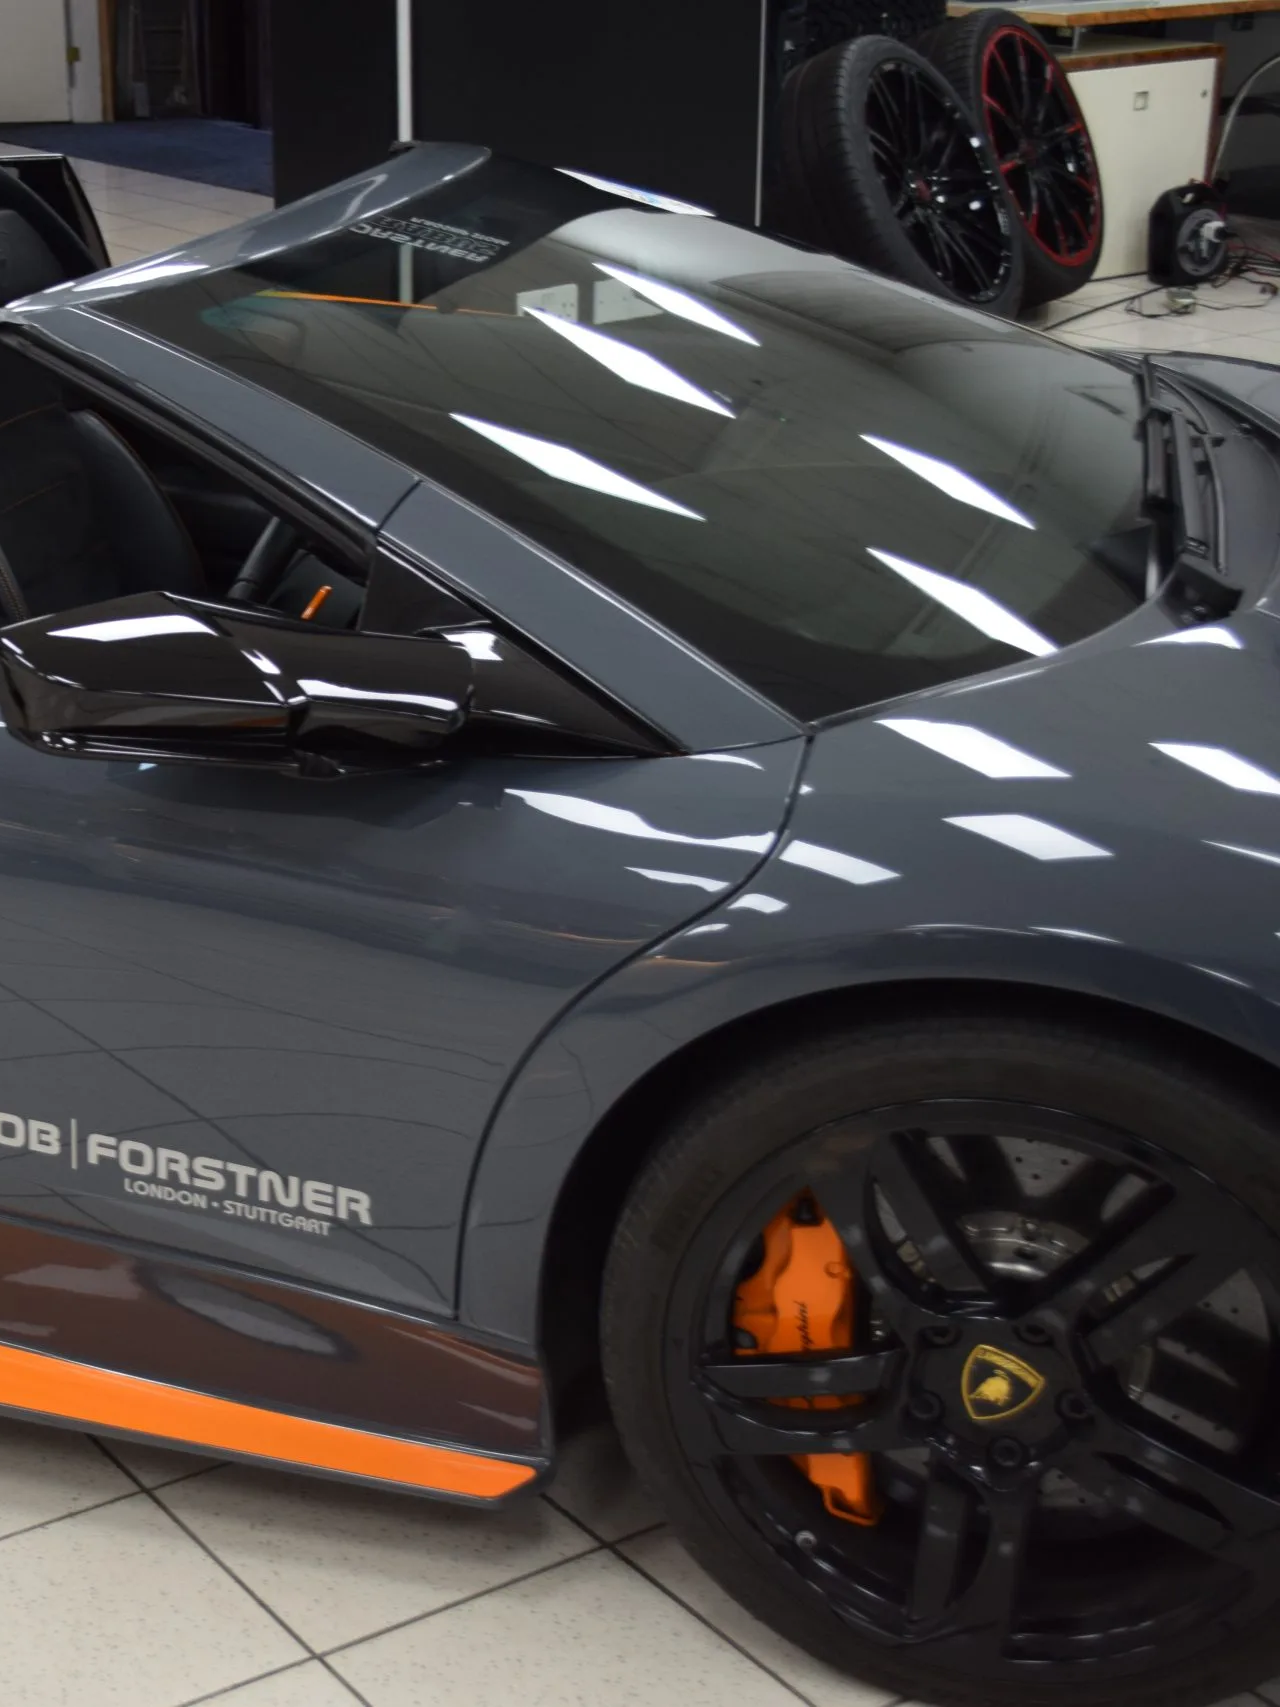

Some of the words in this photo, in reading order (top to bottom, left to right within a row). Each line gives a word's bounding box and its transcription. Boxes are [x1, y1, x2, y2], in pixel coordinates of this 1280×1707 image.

[87, 1133, 373, 1225] FORSTNER
[124, 1178, 208, 1210] LONDON
[223, 1199, 331, 1236] STUTTGART
